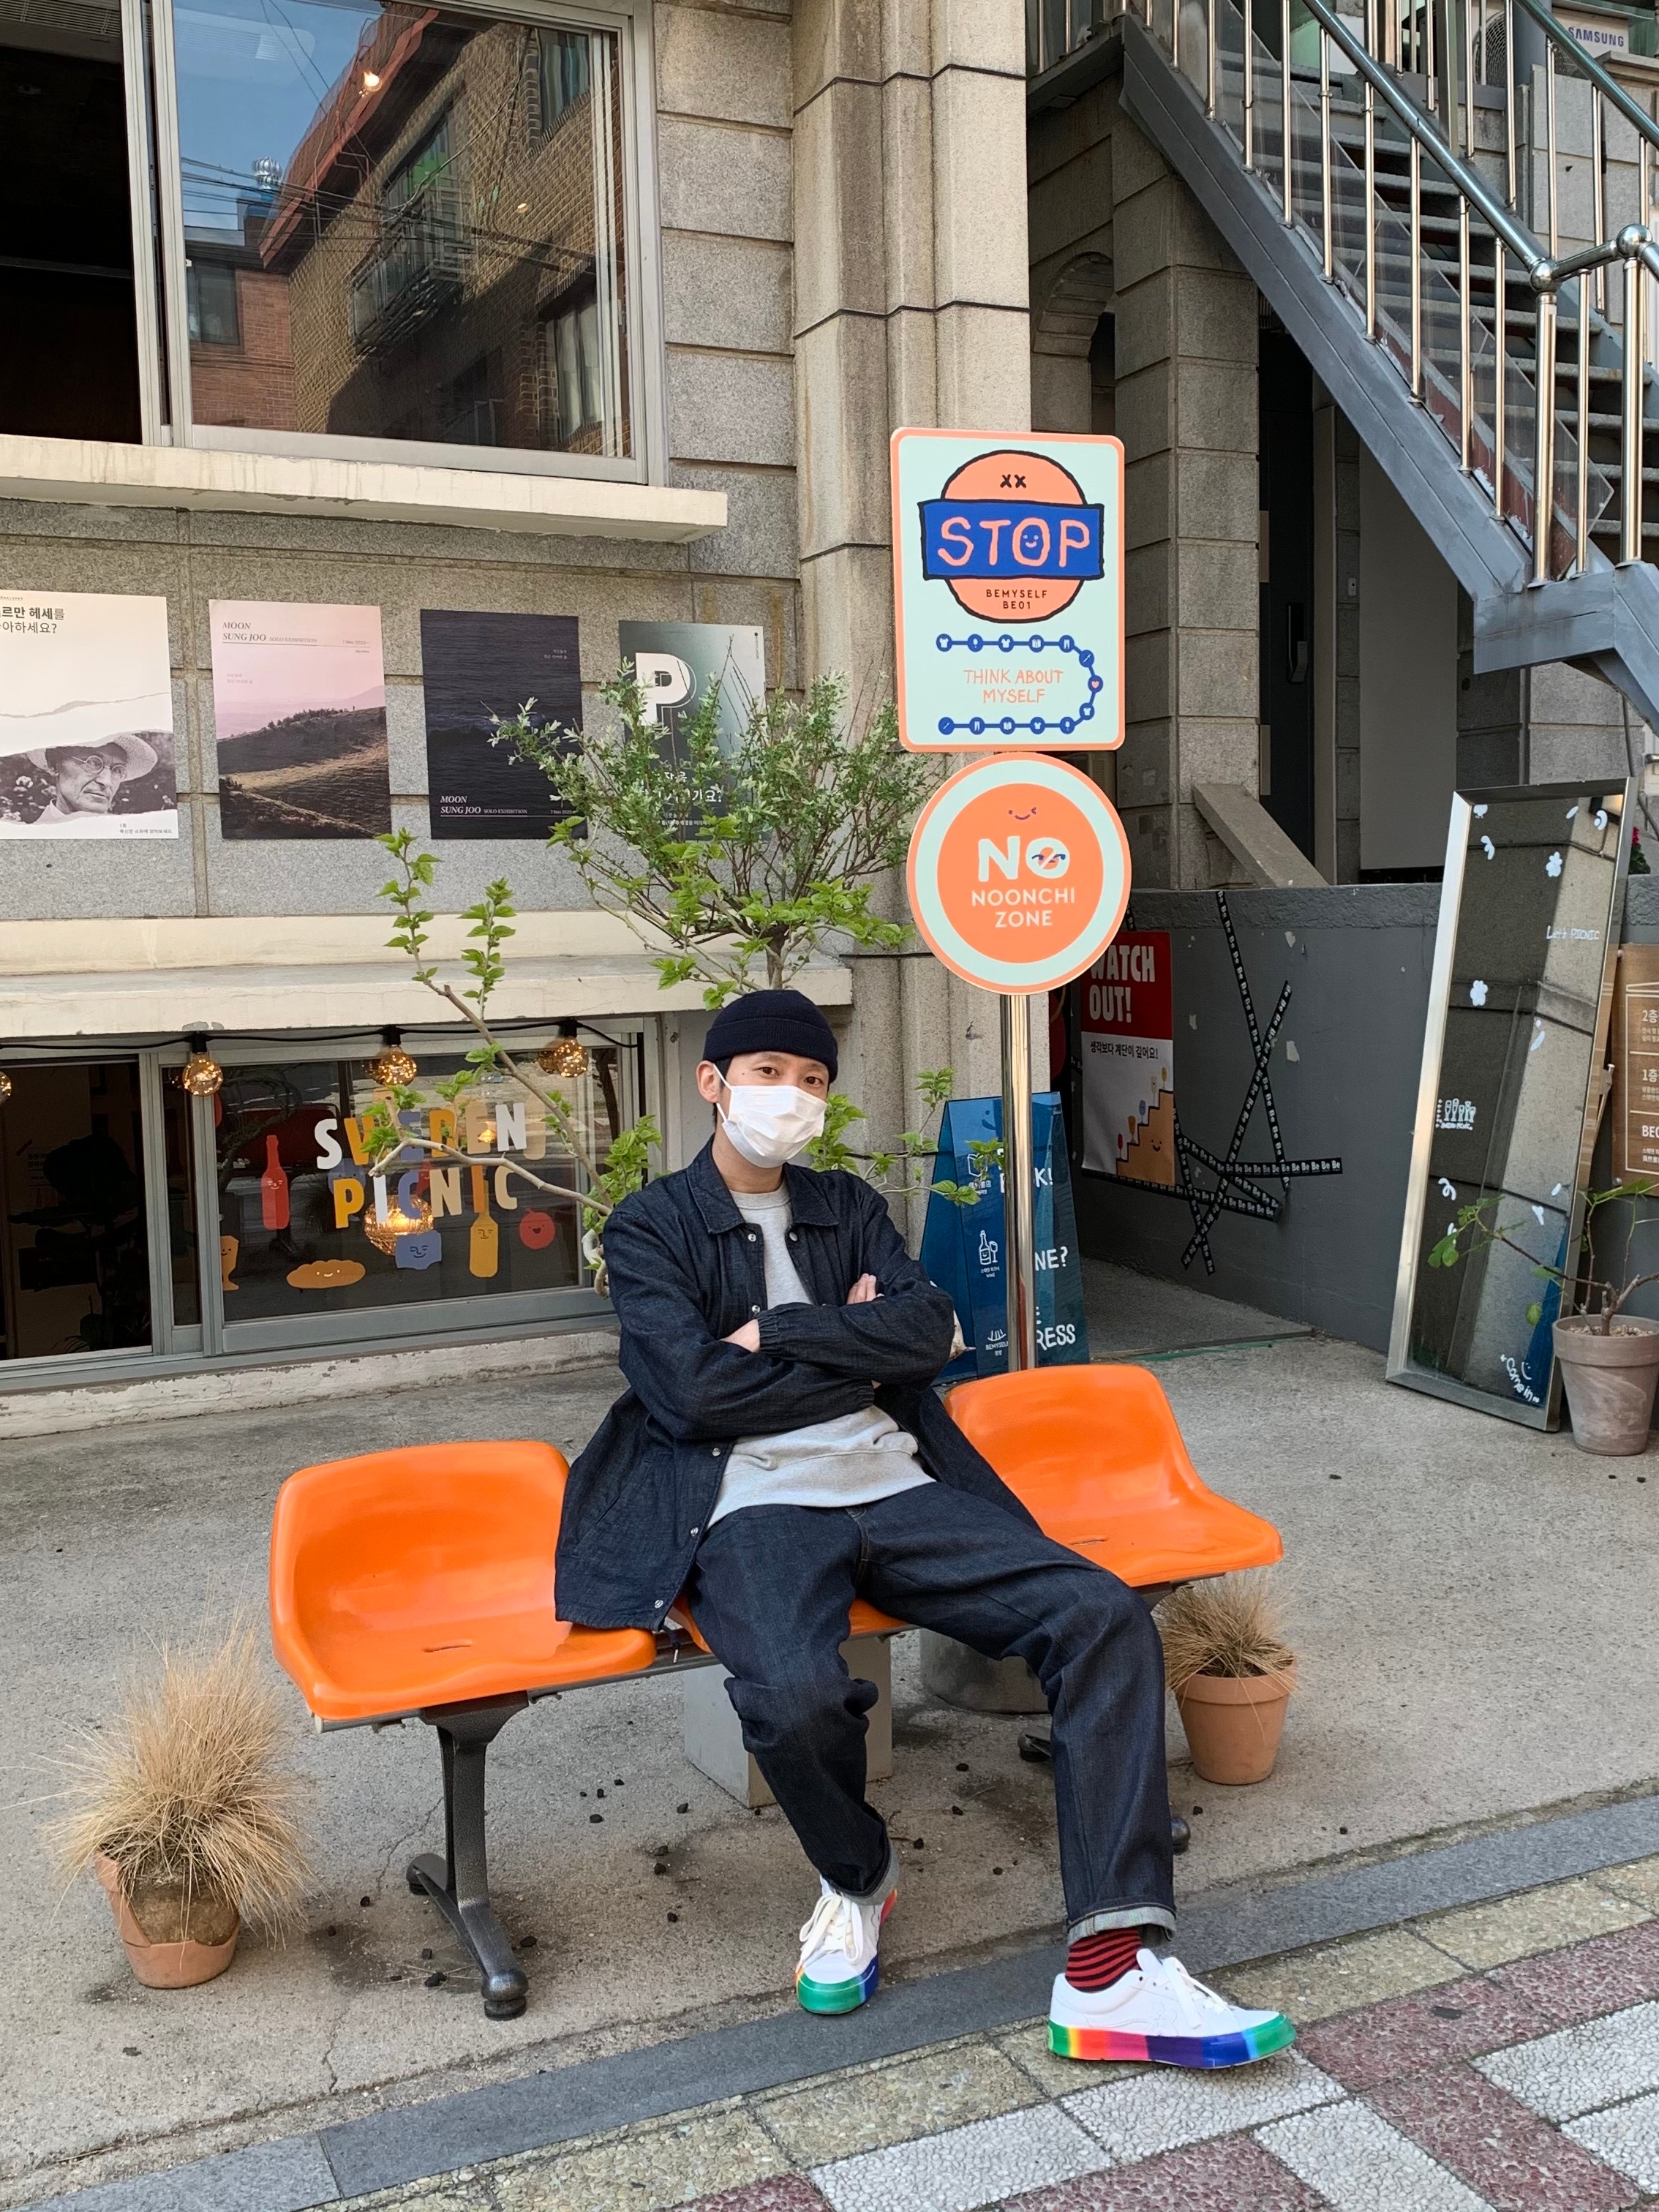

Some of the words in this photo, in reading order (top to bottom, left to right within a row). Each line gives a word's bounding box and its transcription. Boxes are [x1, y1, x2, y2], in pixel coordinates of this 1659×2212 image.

[1568, 26, 1624, 47] SAMSUNG
[938, 516, 1091, 568] STOP
[986, 590, 1047, 598] BEMYSELF
[0, 606, 26, 619] 르만
[29, 607, 64, 620] 헤세를
[1003, 601, 1031, 609] BE01
[0, 620, 57, 633] 아하세요?
[222, 633, 247, 641] SUNG
[249, 633, 266, 642] JOO
[963, 669, 1011, 685] THINK
[1015, 669, 1064, 684] ABOUT
[636, 652, 696, 728] P
[983, 688, 1045, 704] MYSELF
[440, 806, 464, 814] SUNG
[464, 806, 481, 815] JOO
[978, 835, 1070, 882] NO
[971, 887, 1075, 907] NOONCHI
[995, 910, 1053, 929] ZONE
[1091, 945, 1156, 982] WATCH
[1089, 985, 1132, 1023] OUT!
[1091, 1041, 1113, 1055] 생각보다
[1115, 1044, 1134, 1058] 계단이
[1136, 1046, 1158, 1059] 깊어요!
[1642, 1069, 1659, 1083] 1층
[1184, 1138, 1190, 1148] Be
[1192, 1143, 1198, 1153] Be
[1200, 1150, 1207, 1160] Be
[1209, 1156, 1216, 1166] Be
[1226, 1164, 1233, 1172] Be
[1235, 1164, 1242, 1172] Be
[1263, 1165, 1270, 1173] Be
[1282, 1163, 1290, 1172] Be
[1292, 1163, 1299, 1171] Be
[1301, 1162, 1309, 1170] Be
[1311, 1162, 1320, 1170] Be
[1321, 1161, 1330, 1169] Be
[1331, 1160, 1340, 1169] Be
[334, 1165, 518, 1229] PICNIC
[1034, 1246, 1068, 1271] NE?
[1037, 1324, 1075, 1350] RESS
[1507, 1358, 1524, 1393] Come
